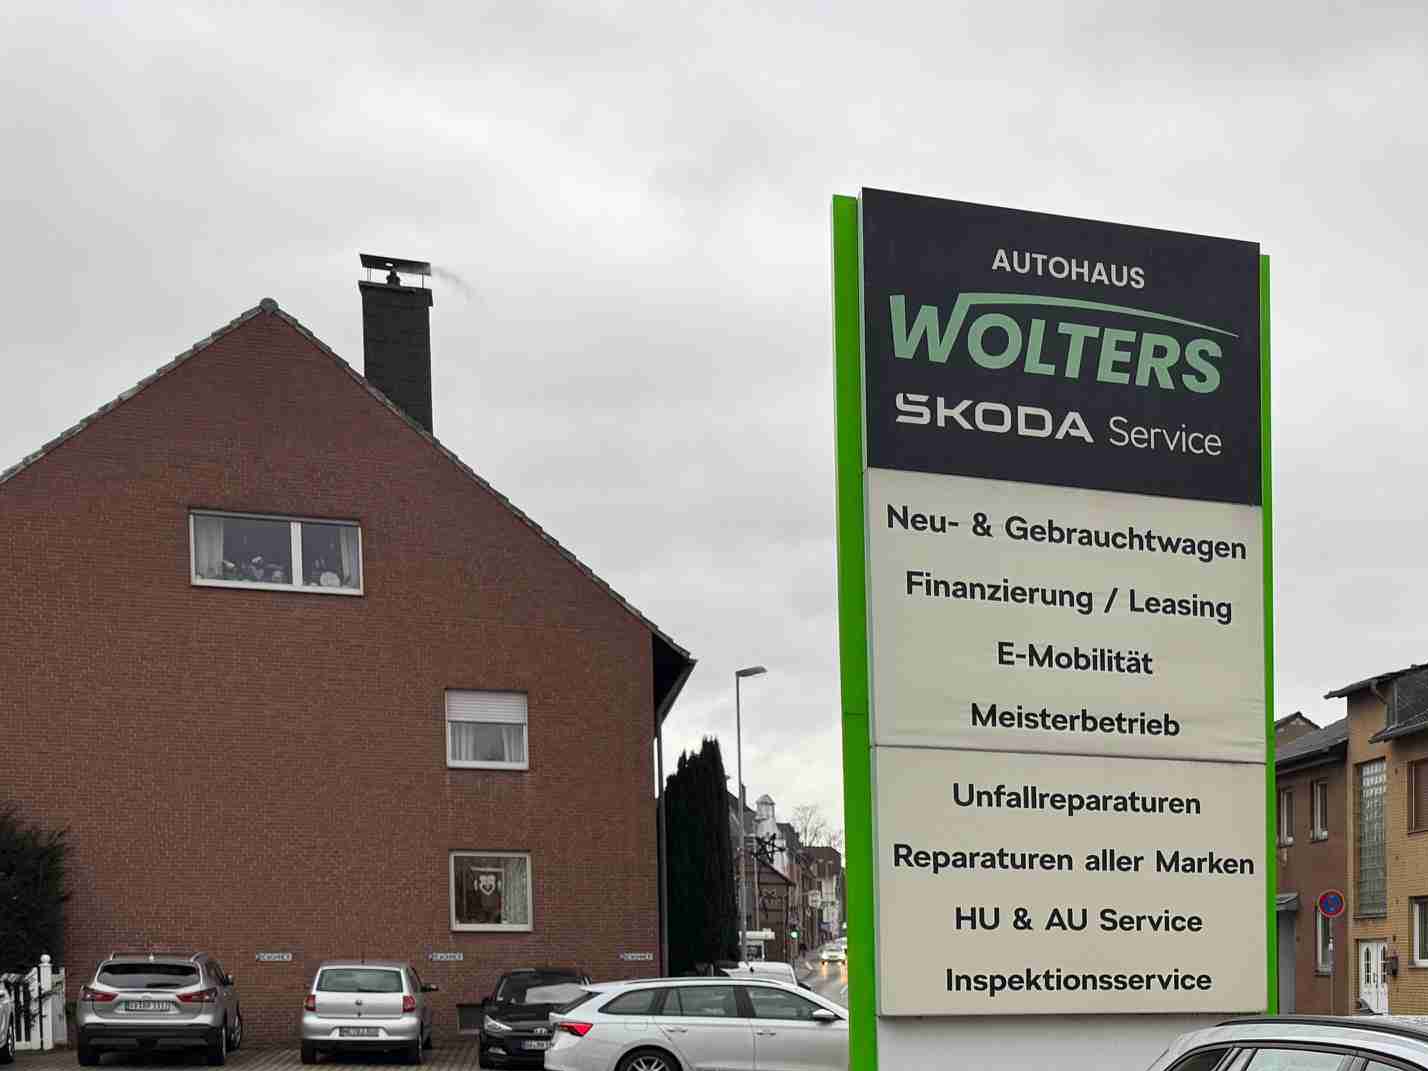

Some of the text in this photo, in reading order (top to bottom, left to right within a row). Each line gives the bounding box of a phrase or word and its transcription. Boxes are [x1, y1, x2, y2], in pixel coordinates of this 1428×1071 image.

[992, 248, 1146, 289] AUTOHAUS
[889, 292, 1224, 394] WOLTERS
[1109, 416, 1223, 456] Service
[886, 504, 1247, 563] Neu- & Gebrauchtwagen
[905, 571, 1233, 625] Finanzierung / Leasing
[997, 641, 1154, 675] E-Mobilität
[970, 703, 1181, 737] Meisterbetrieb
[953, 783, 1201, 816] Unfallreparaturen
[893, 844, 1255, 875] Reparaturen aller Marken
[955, 907, 1204, 932] HU & AU Service
[946, 969, 1212, 998] Inspektionsservice
